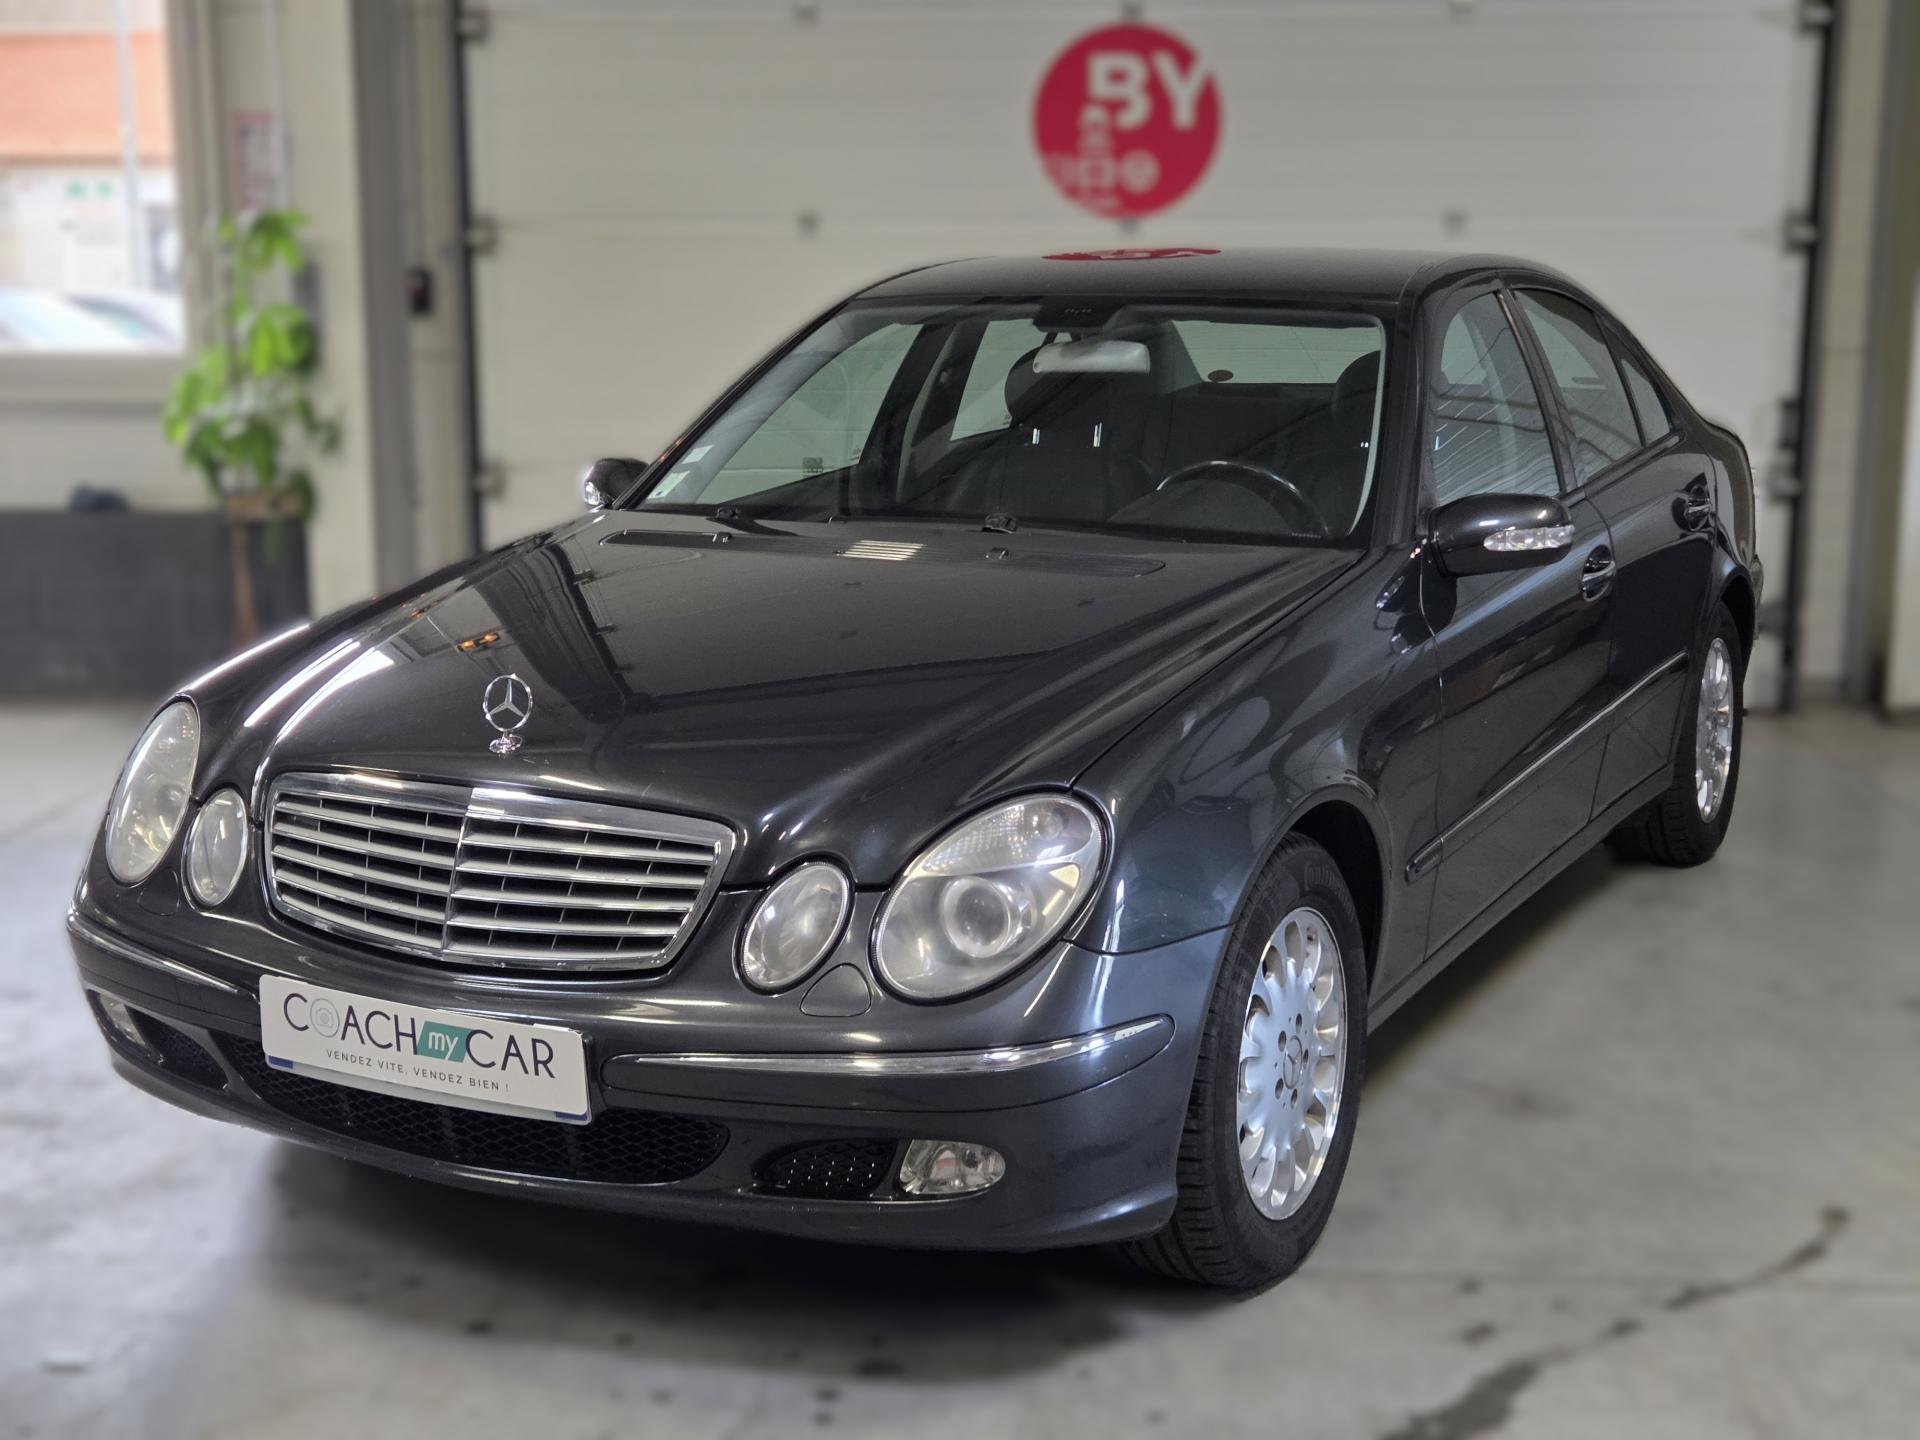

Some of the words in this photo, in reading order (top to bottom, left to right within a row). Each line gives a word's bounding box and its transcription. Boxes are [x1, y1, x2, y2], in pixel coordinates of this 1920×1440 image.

[1087, 50, 1211, 130] BY
[326, 1049, 373, 1068] VENDEZ
[413, 1066, 463, 1085] VENDEZ
[469, 1077, 500, 1092] BIEN
